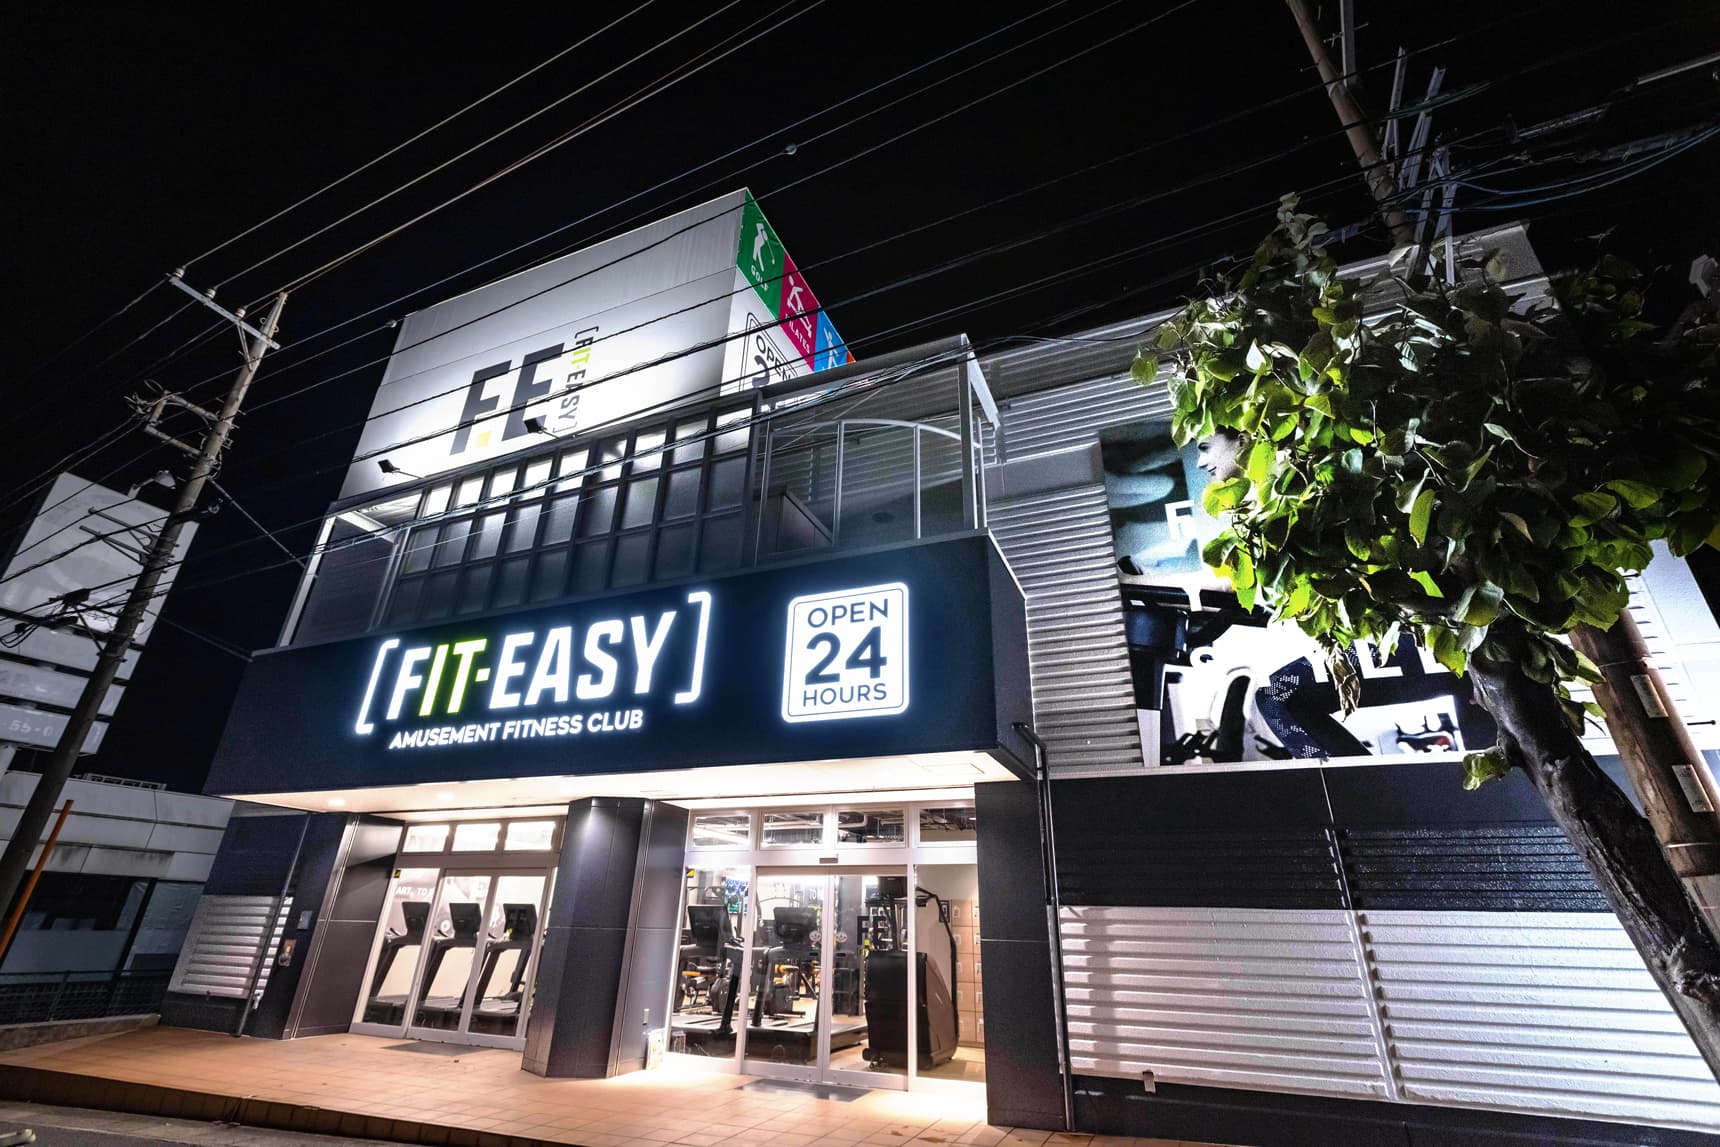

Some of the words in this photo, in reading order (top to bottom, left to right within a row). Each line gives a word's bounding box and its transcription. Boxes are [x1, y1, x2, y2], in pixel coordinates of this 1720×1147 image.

[807, 598, 889, 628] OPEN
[804, 626, 888, 685] 24
[803, 683, 888, 707] HOURS
[388, 722, 501, 750] AMUSEMENT
[502, 714, 584, 740] FITNESS
[586, 709, 644, 732] CLUB
